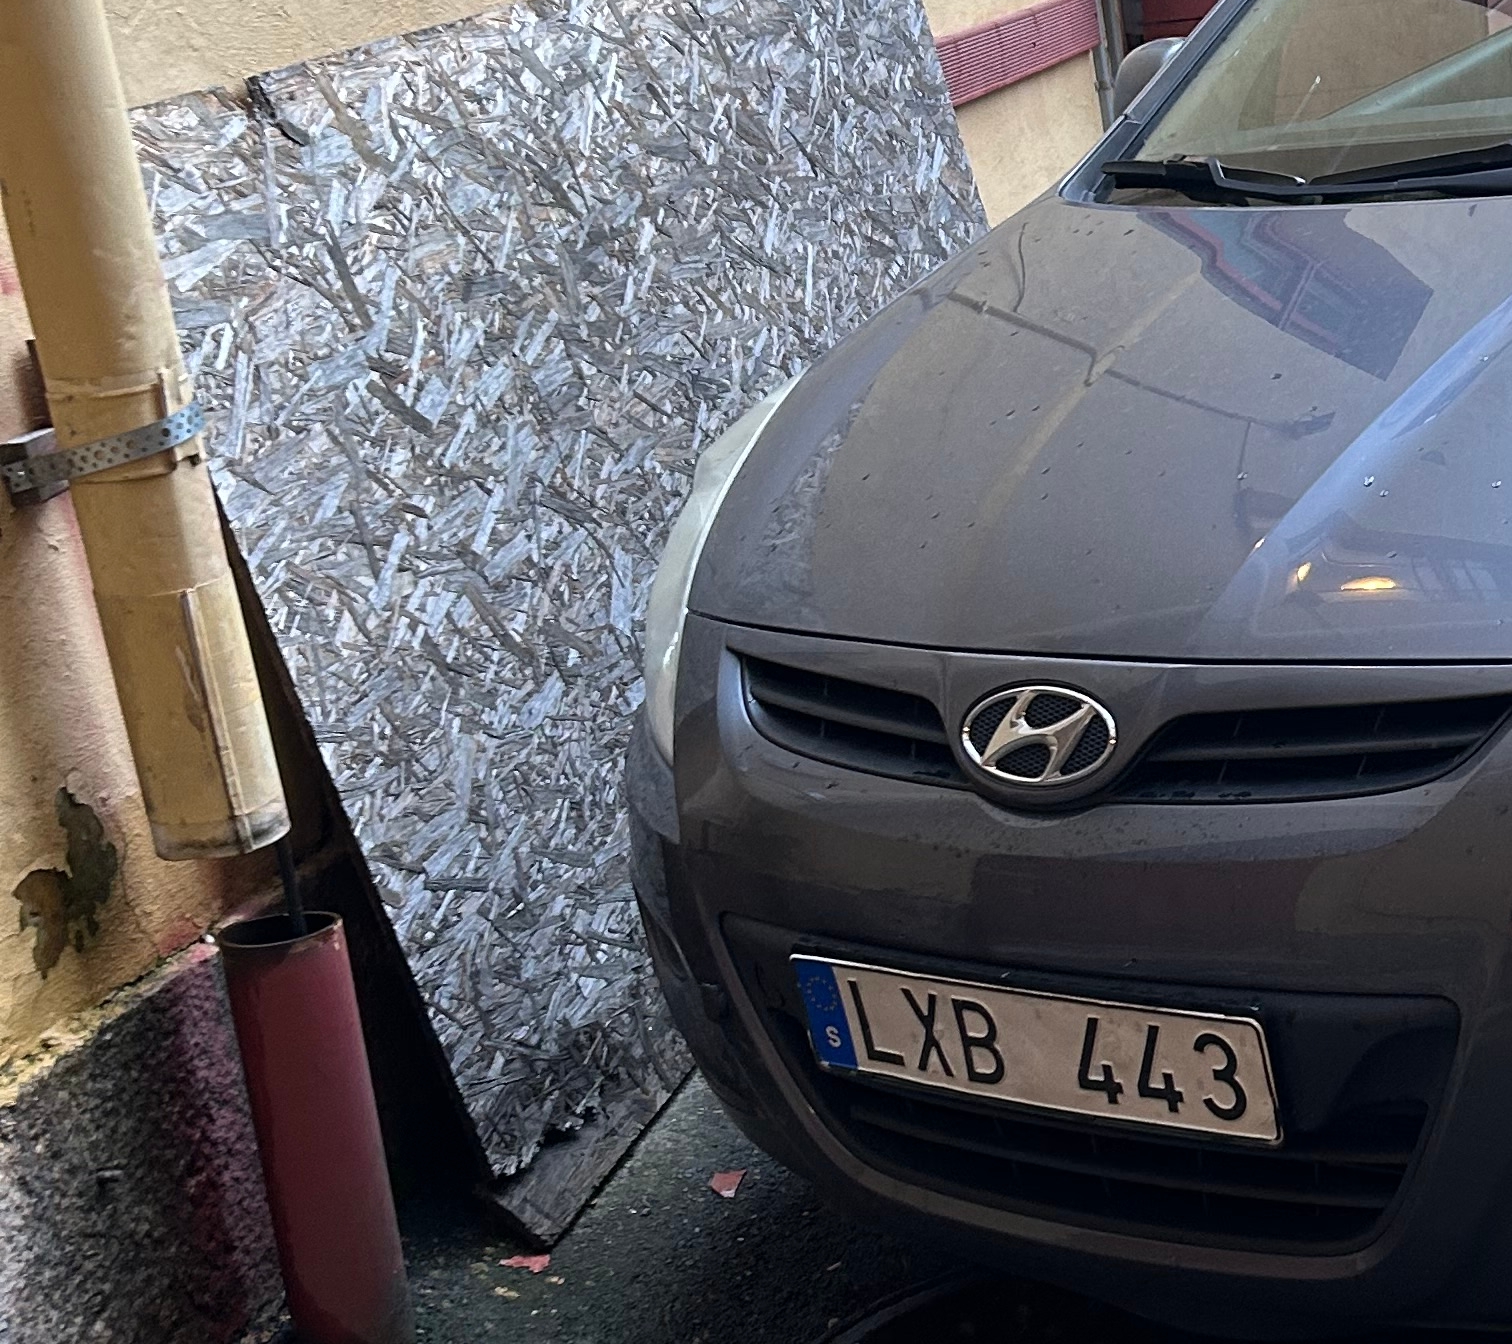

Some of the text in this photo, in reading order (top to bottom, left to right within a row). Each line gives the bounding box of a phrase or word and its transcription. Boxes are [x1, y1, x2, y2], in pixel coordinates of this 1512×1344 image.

[825, 1025, 842, 1048] S
[848, 979, 1247, 1121] LXB 443
